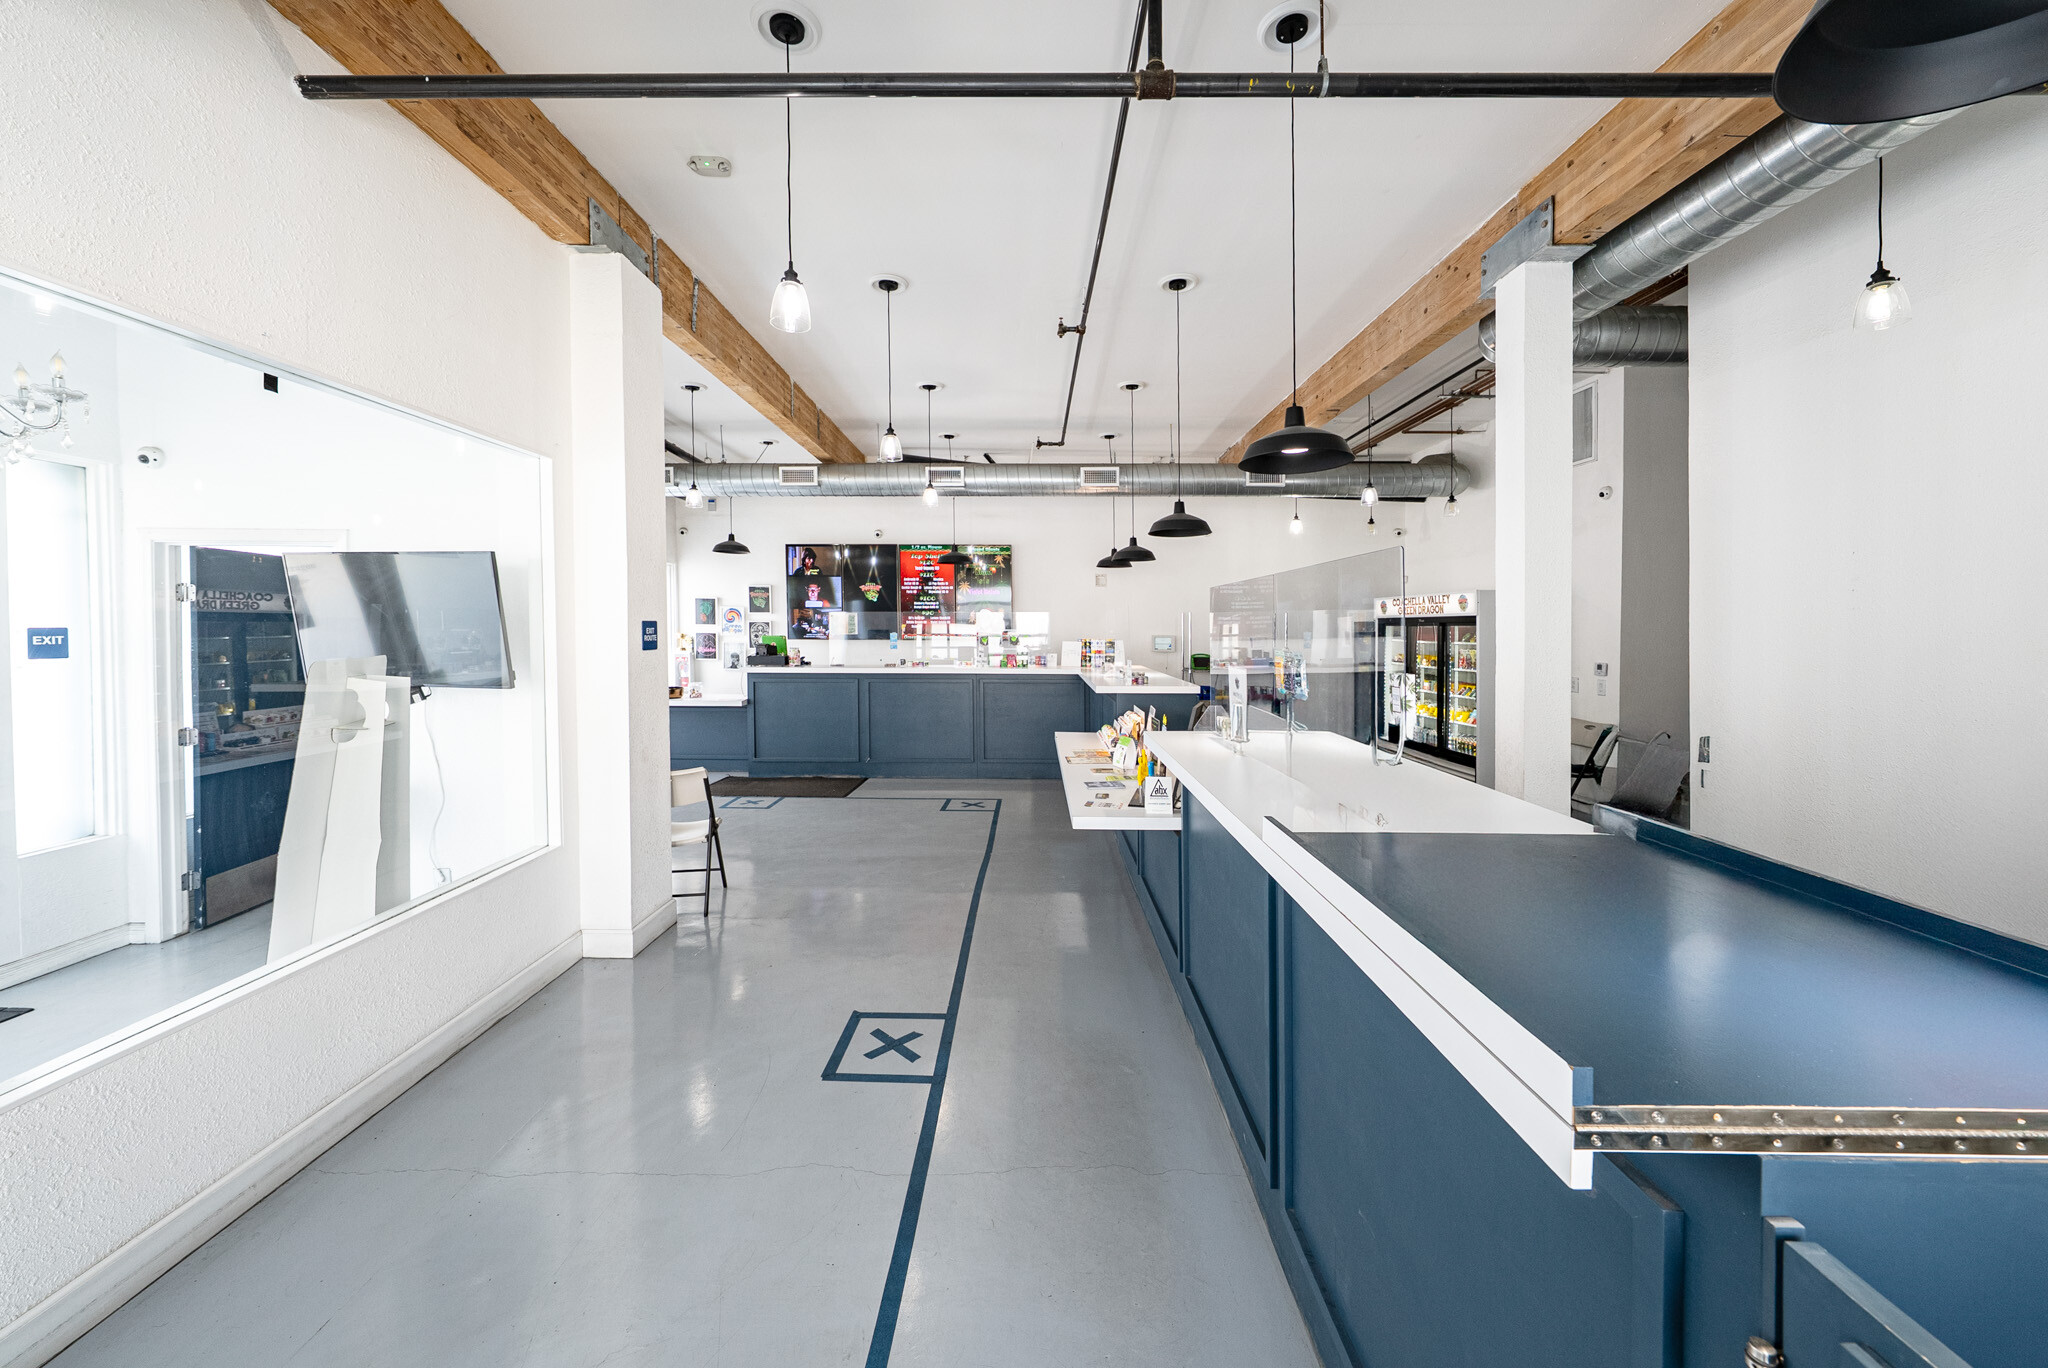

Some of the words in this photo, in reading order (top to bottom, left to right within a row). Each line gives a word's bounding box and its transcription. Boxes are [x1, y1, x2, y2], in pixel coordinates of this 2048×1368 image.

[1392, 597, 1426, 607] COCHELLA
[1427, 594, 1451, 604] VALLEY
[1418, 605, 1444, 615] DRAGON
[646, 627, 655, 635] EXIT
[32, 635, 65, 646] EXIT
